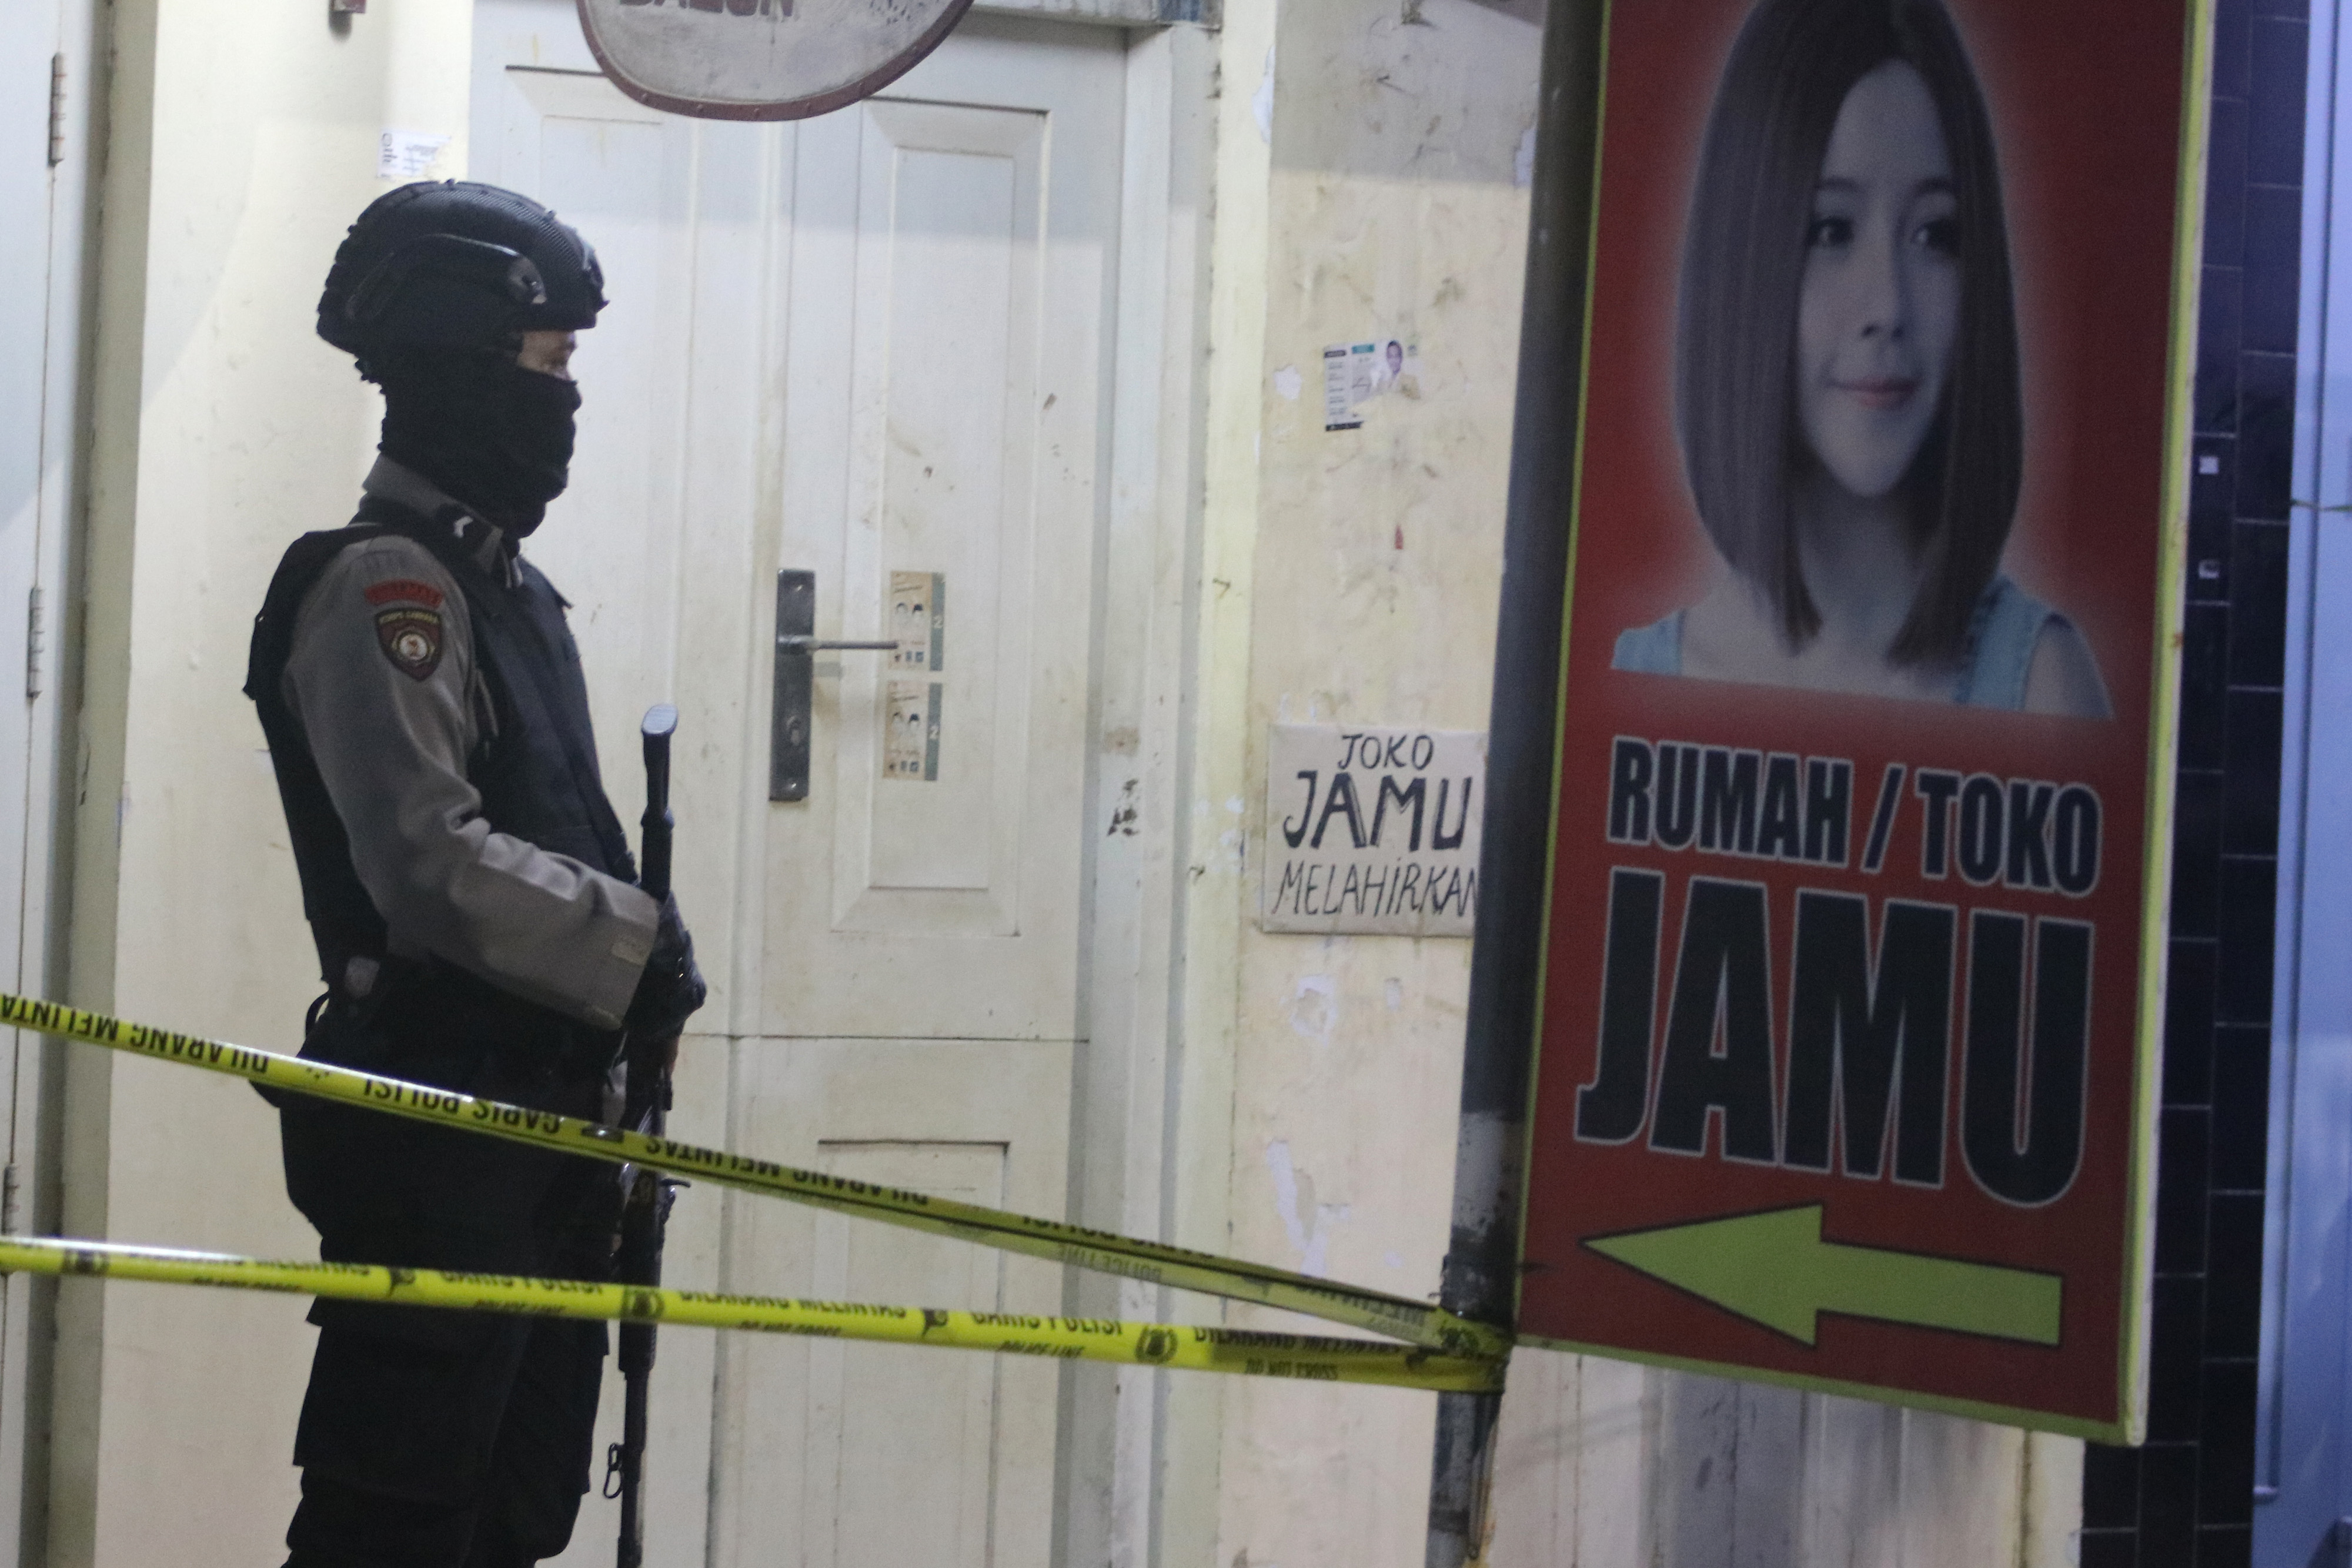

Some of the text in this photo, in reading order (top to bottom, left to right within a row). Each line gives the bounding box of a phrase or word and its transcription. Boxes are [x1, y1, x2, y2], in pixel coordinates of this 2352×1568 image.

[1282, 770, 1472, 853] JAMU
[1606, 735, 1853, 869] RUMAH
[1915, 767, 2103, 899] TOKO
[1573, 865, 2095, 1208] JAMU
